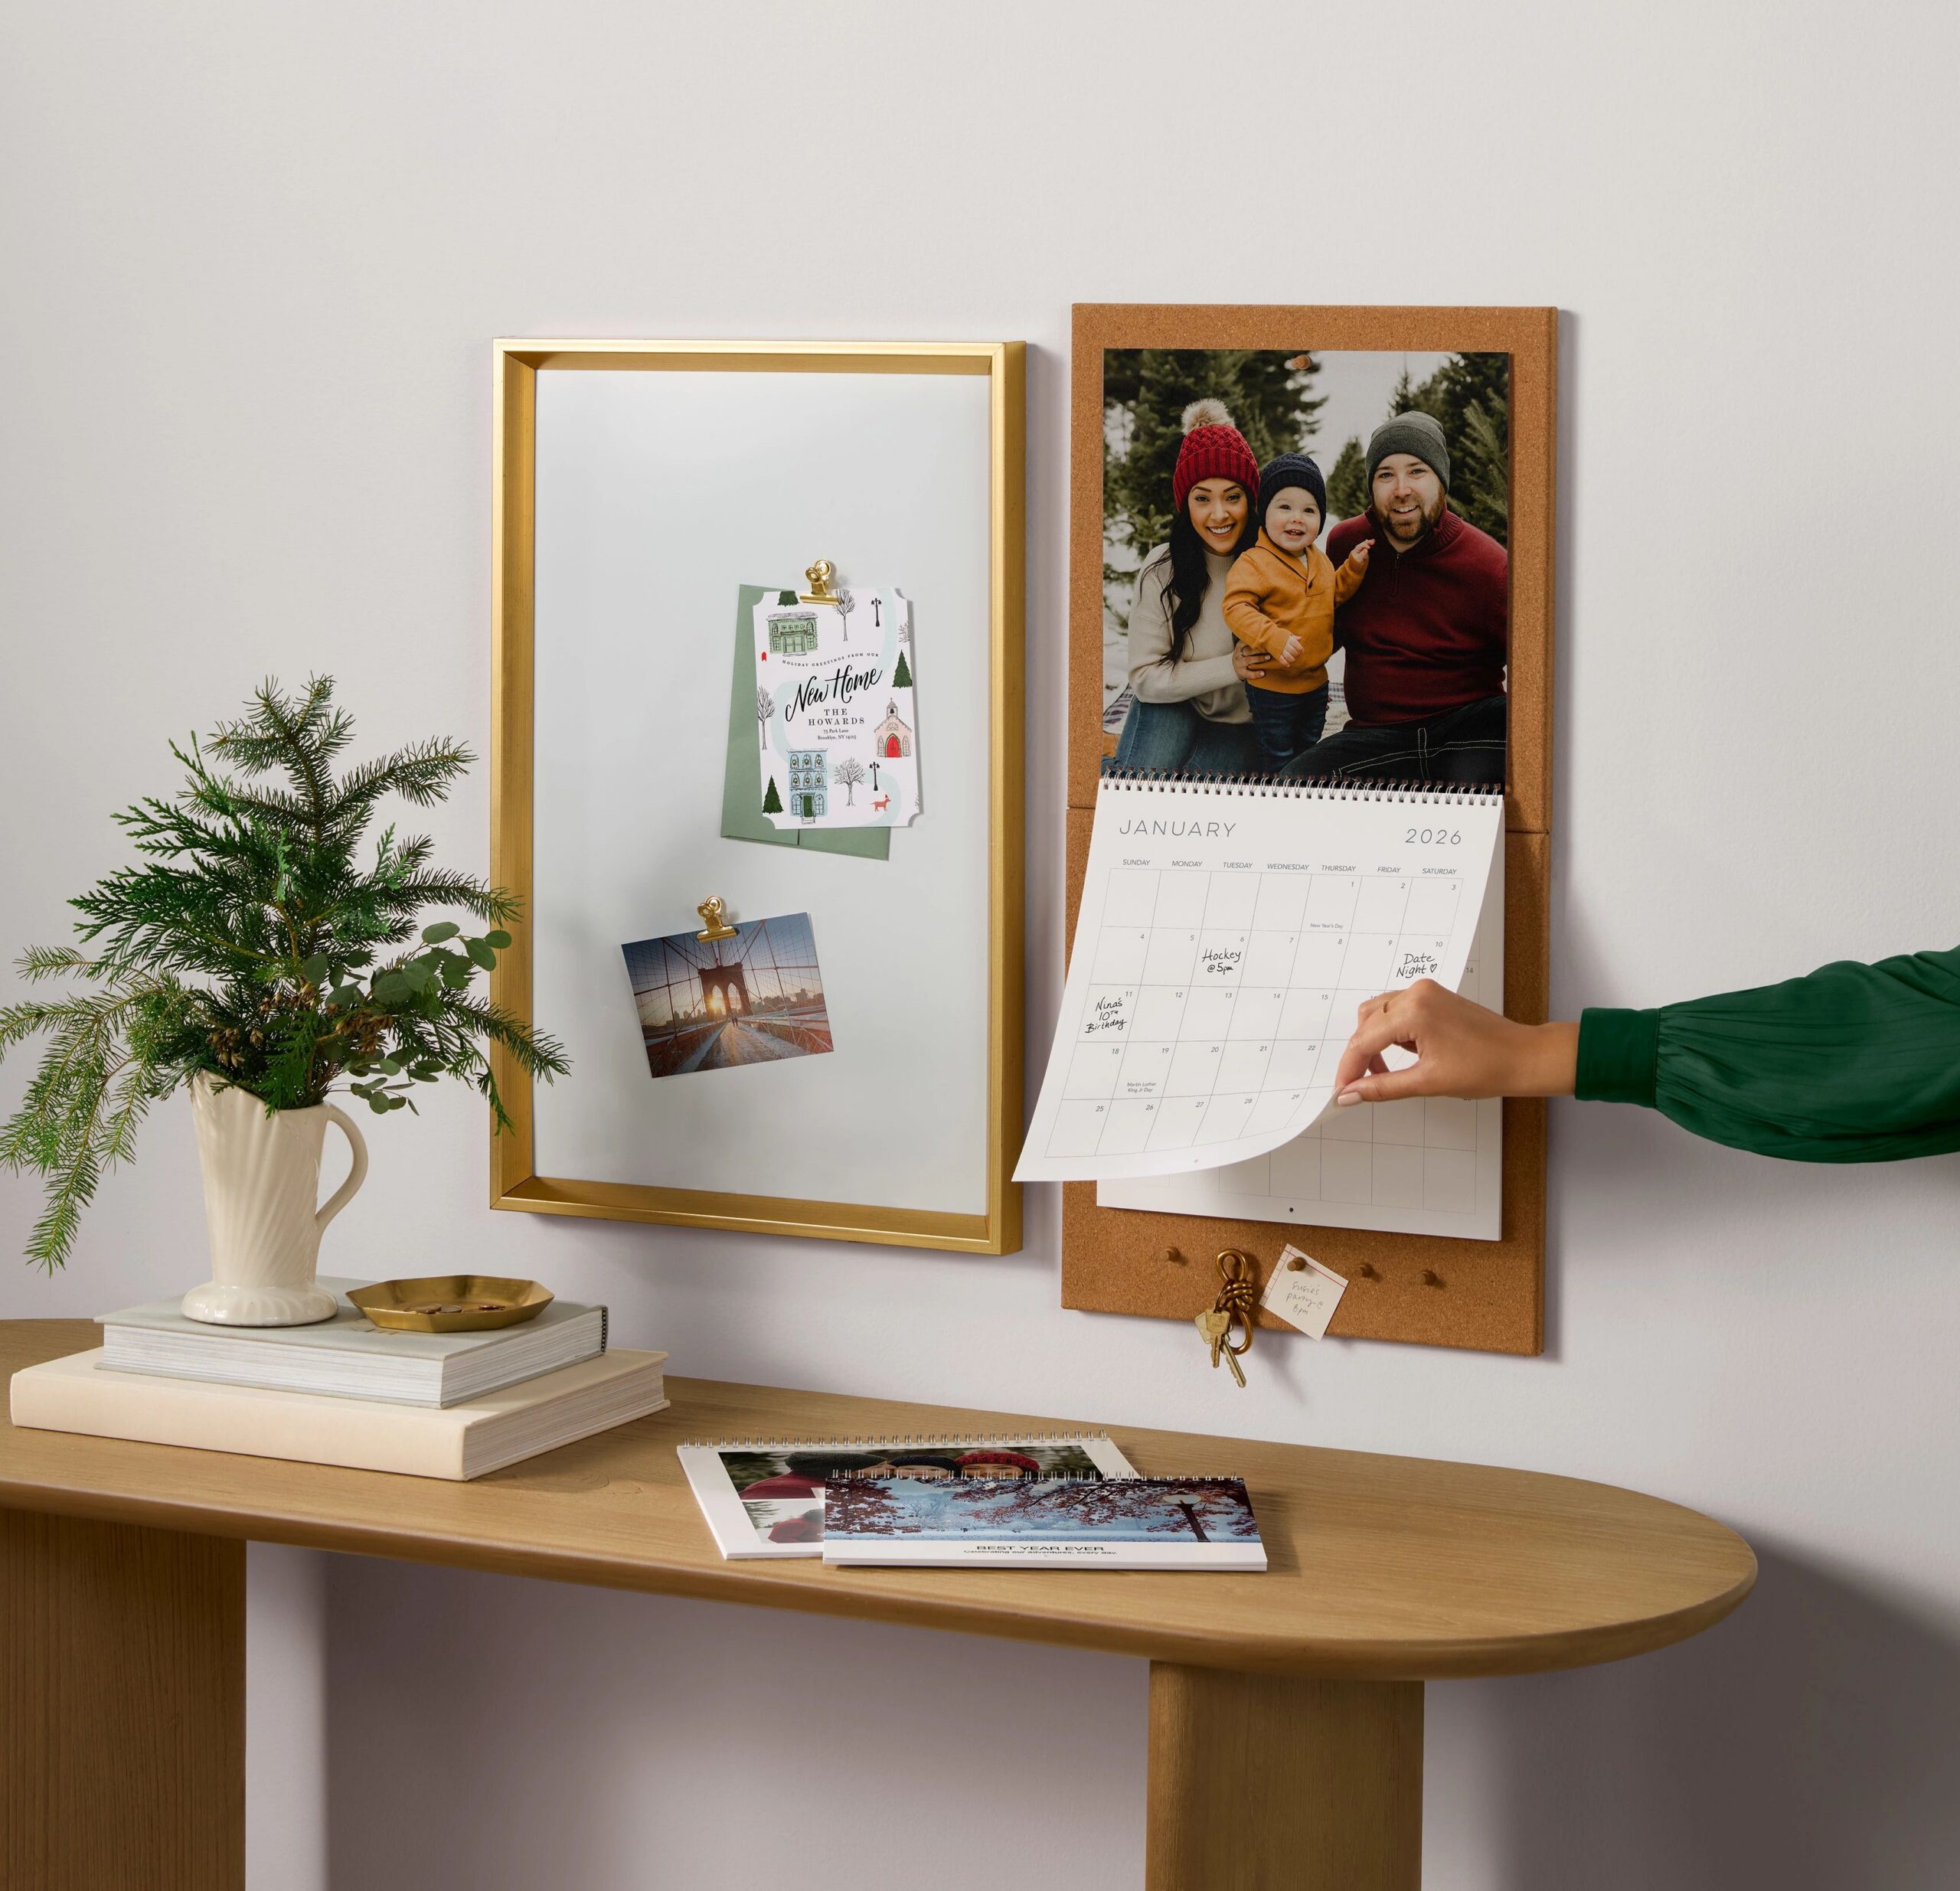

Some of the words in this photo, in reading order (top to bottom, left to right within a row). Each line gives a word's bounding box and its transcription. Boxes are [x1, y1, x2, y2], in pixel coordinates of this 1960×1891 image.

[812, 656, 844, 667] GREETINGS
[785, 675, 828, 722] New
[825, 665, 883, 704] Home
[808, 717, 864, 726] HOWARDS
[1119, 819, 1236, 838] JANUARY
[1405, 828, 1462, 844] 2026
[1202, 949, 1241, 962] Hockey
[1403, 952, 1436, 965] Date
[1396, 966, 1426, 978] Night
[1096, 997, 1123, 1011] Nina's
[1085, 1018, 1127, 1034] Birthday
